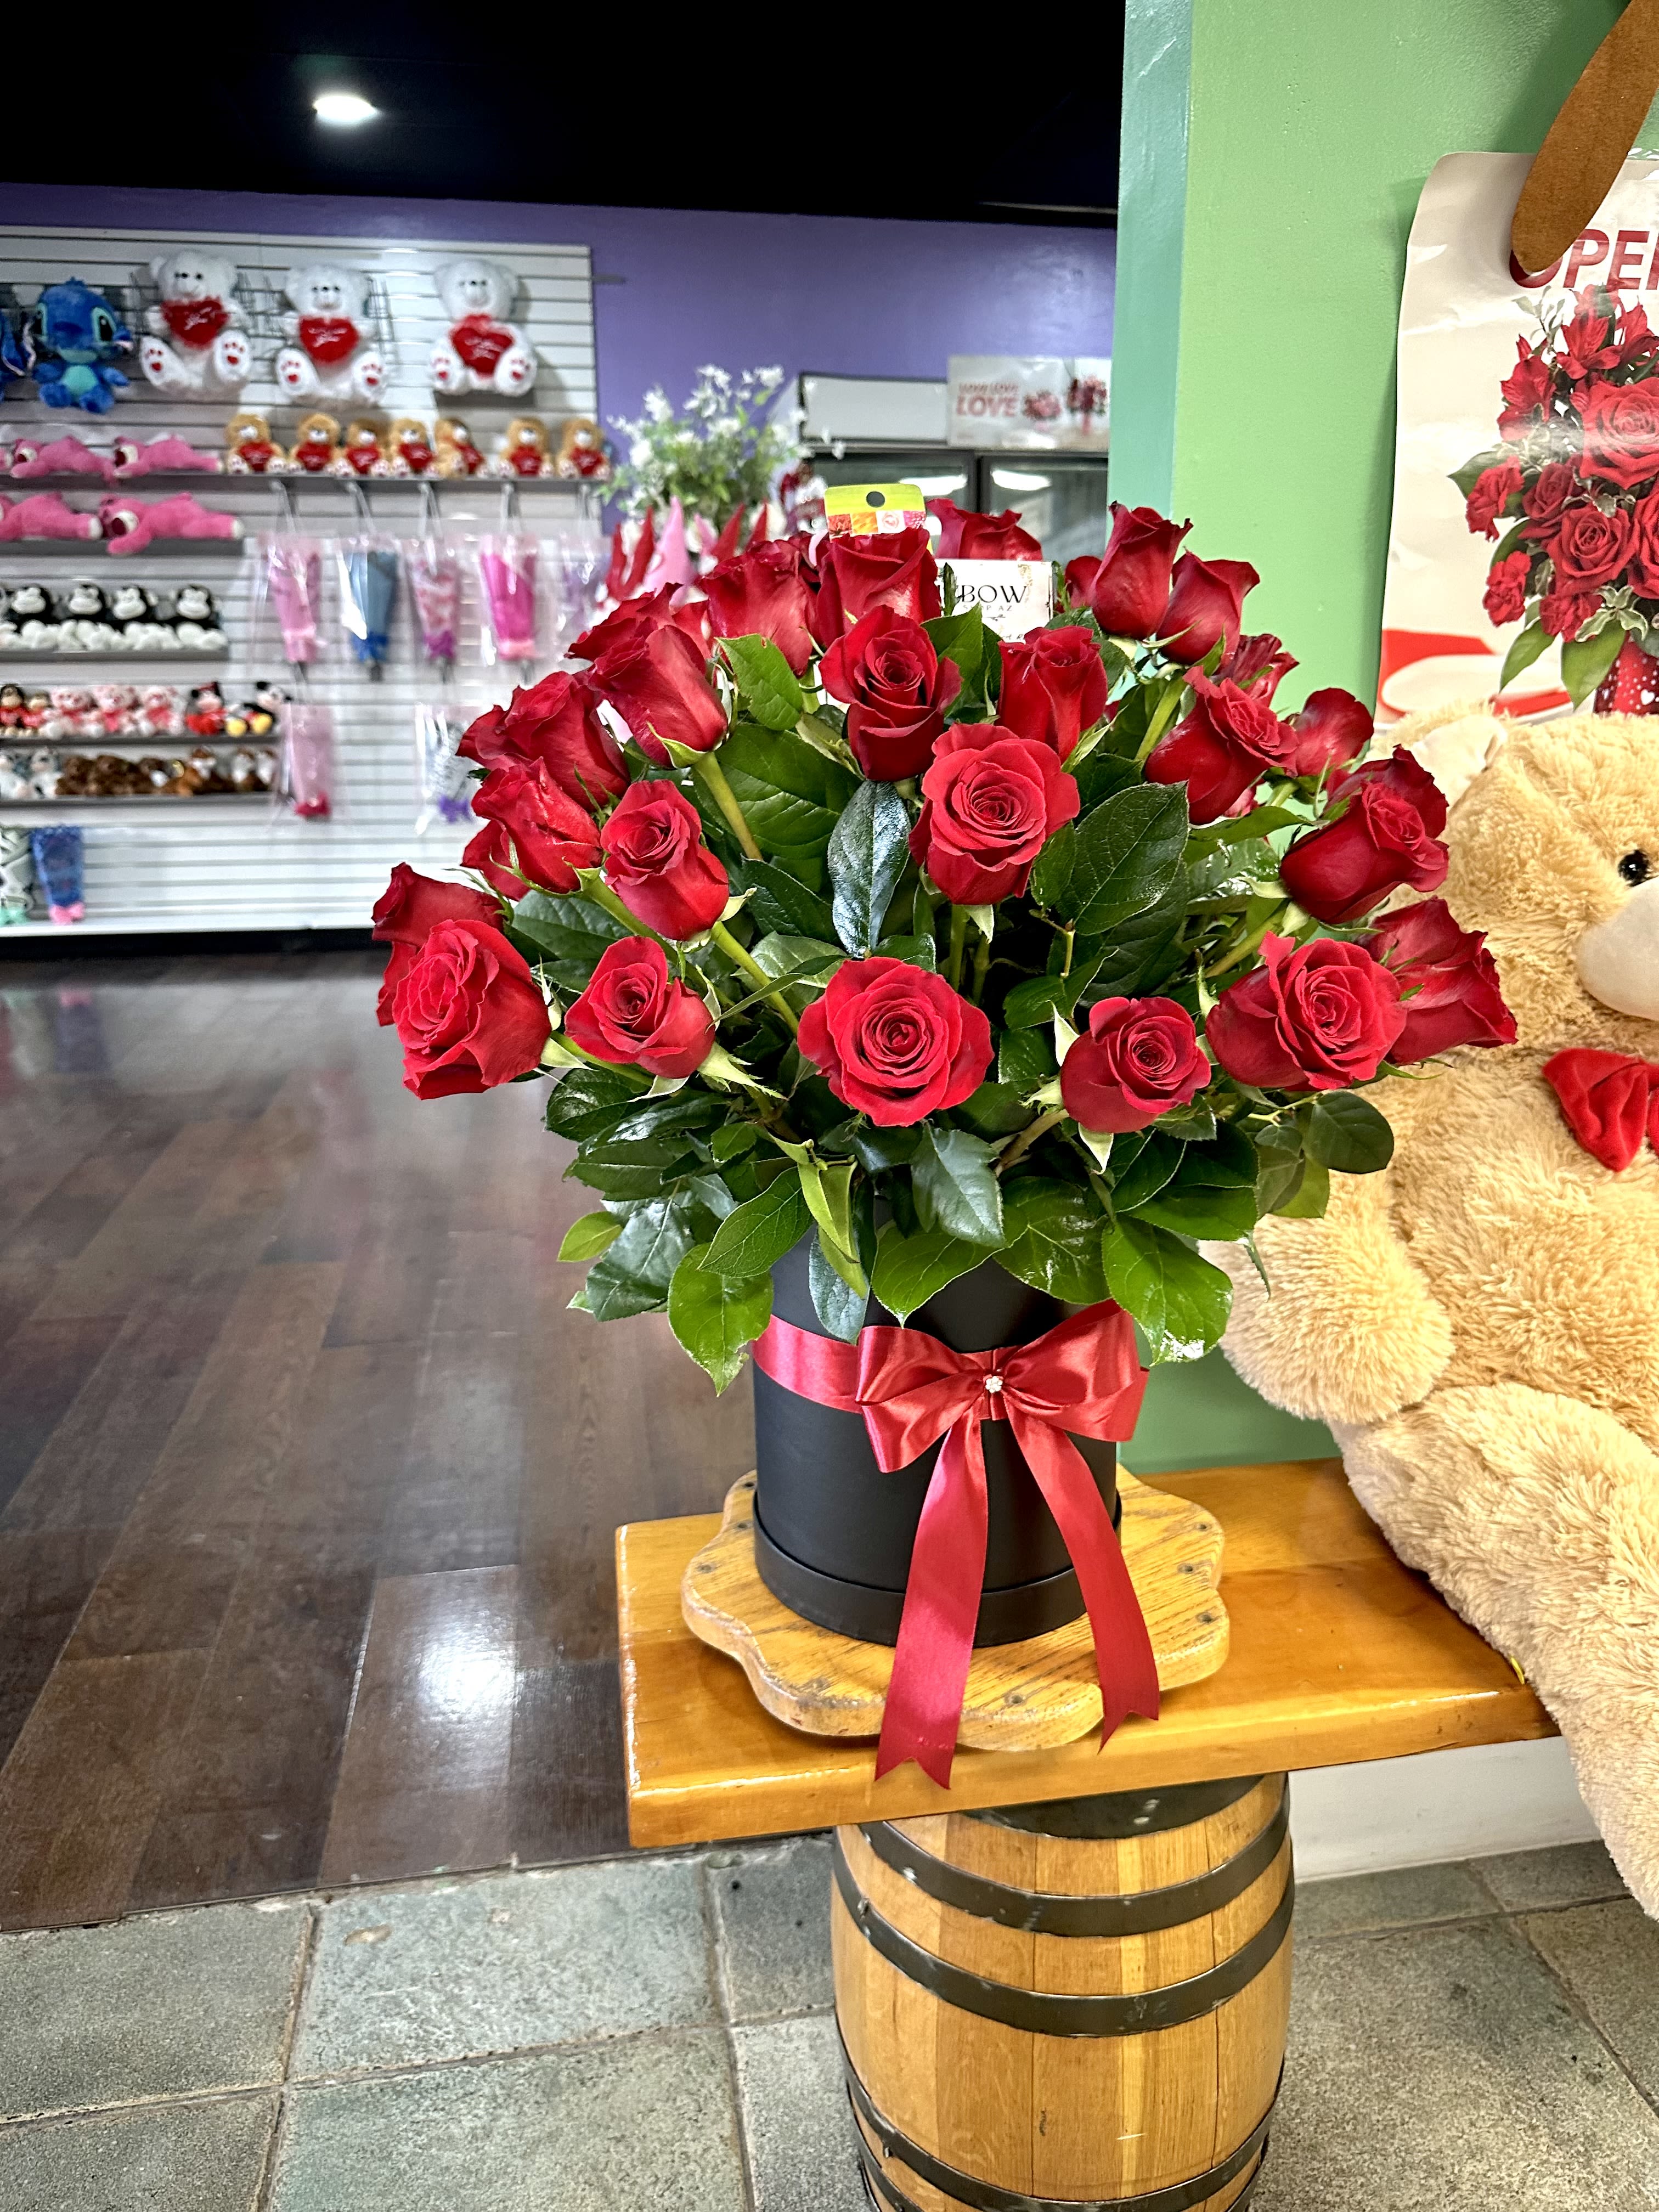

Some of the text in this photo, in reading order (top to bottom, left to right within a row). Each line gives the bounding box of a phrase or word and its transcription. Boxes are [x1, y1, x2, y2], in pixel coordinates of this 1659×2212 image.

[1509, 229, 1659, 290] OPE
[956, 395, 1018, 417] LOVE
[957, 585, 1026, 603] BOW
